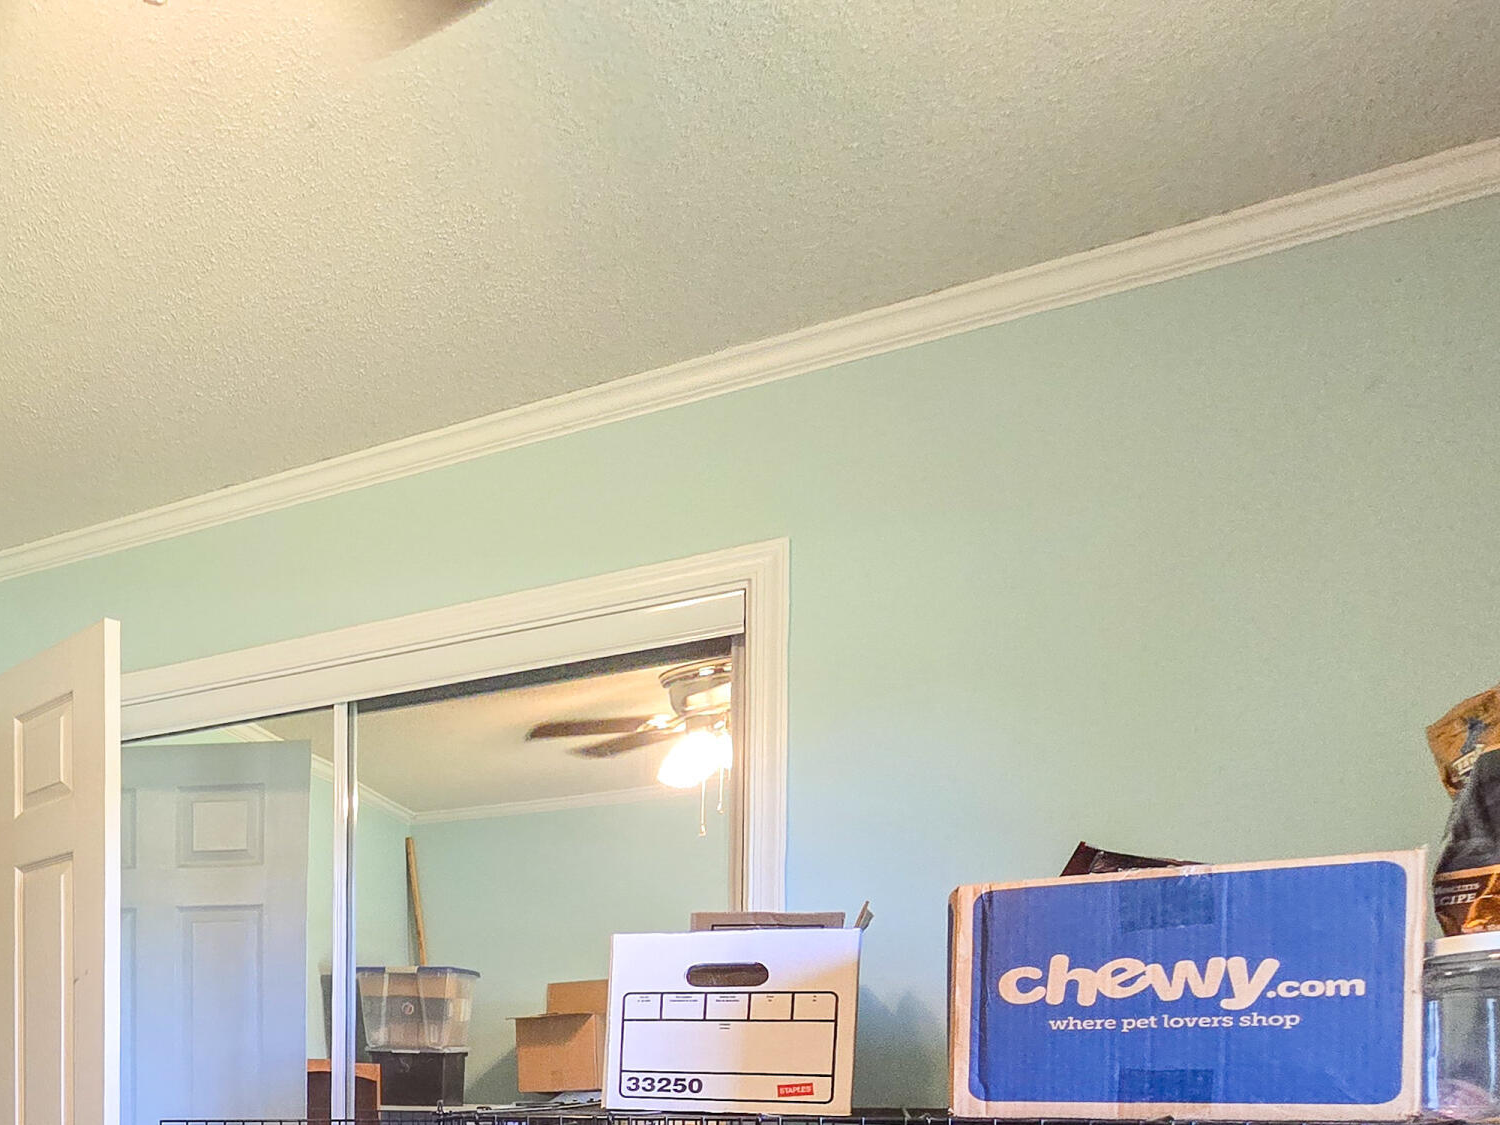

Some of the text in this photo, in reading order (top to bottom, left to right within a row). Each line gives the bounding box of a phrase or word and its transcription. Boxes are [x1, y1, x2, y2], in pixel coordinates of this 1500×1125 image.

[997, 954, 1366, 1010] chewy.com
[1048, 1012, 1303, 1033] where pet lovers shop
[626, 1077, 703, 1094] 33250
